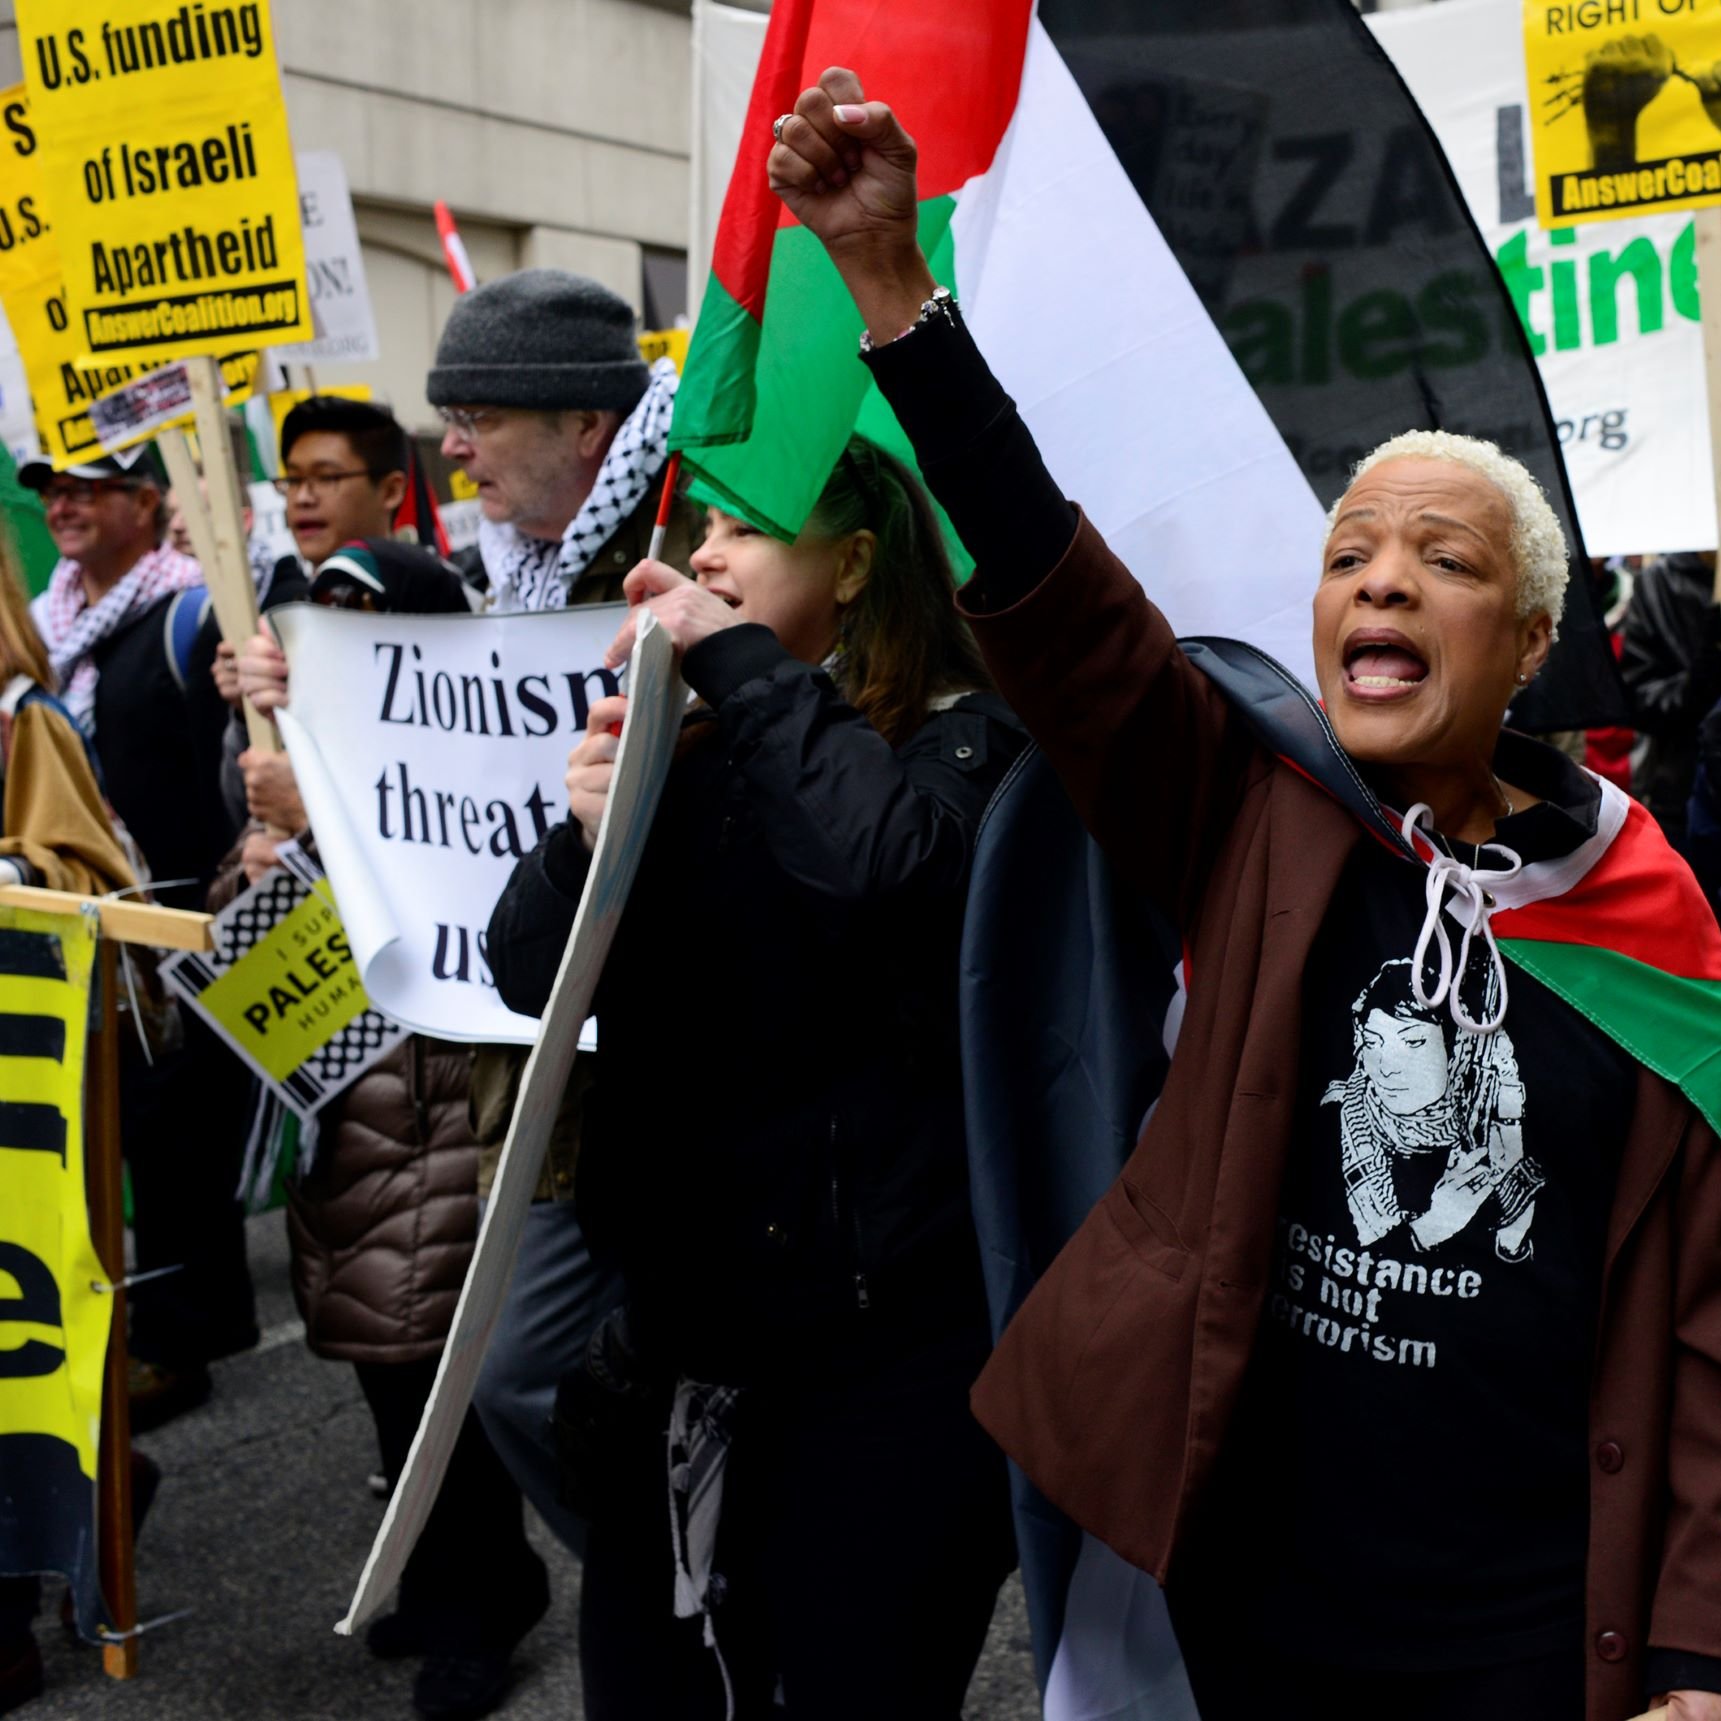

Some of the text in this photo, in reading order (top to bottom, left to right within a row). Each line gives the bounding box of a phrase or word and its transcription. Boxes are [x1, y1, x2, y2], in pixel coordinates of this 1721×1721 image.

[36, 2, 263, 90] U.S. funding
[4, 97, 36, 156] S
[85, 122, 258, 204] of Israeli
[1561, 152, 1721, 211] AnswerCoa
[92, 215, 278, 297] Apartheid
[89, 286, 297, 346] AnswerCoalition.org
[243, 930, 353, 1036] PALES
[1284, 1221, 1483, 1299] esistance
[1319, 1274, 1383, 1324] not
